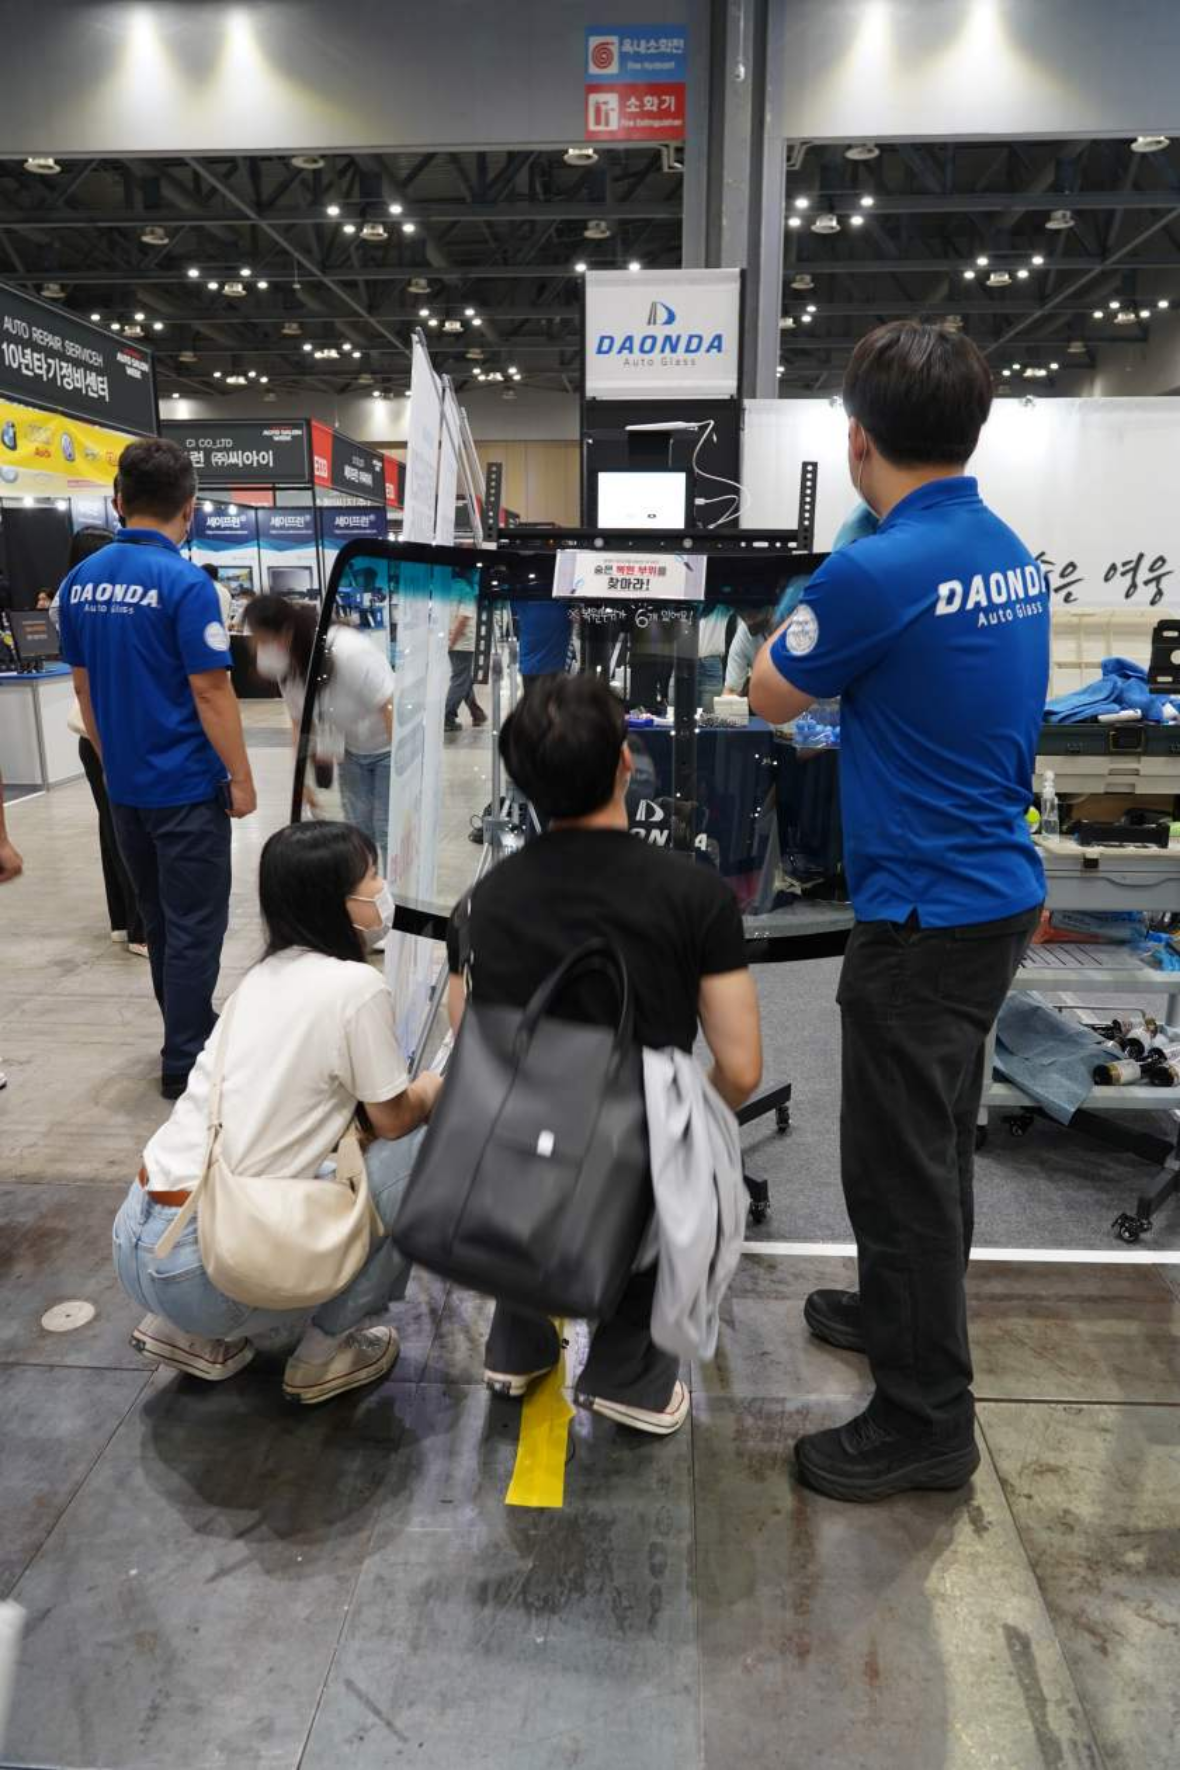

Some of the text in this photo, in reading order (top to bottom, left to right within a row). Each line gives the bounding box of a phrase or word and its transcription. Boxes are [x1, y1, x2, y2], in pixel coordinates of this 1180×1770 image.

[622, 38, 684, 54] 옥내소화전
[625, 96, 675, 113] 소화기
[3, 315, 29, 339] AUTO
[31, 327, 63, 353] REPAIR
[595, 334, 724, 355] DAONDA
[1, 341, 110, 403] 10년타기정비센터
[623, 357, 697, 367] Auto Glass
[607, 577, 651, 591] 찾아라!
[1103, 552, 1174, 606] 영웅
[70, 583, 160, 608] DAONDA
[978, 601, 1043, 628] Auto Glass
